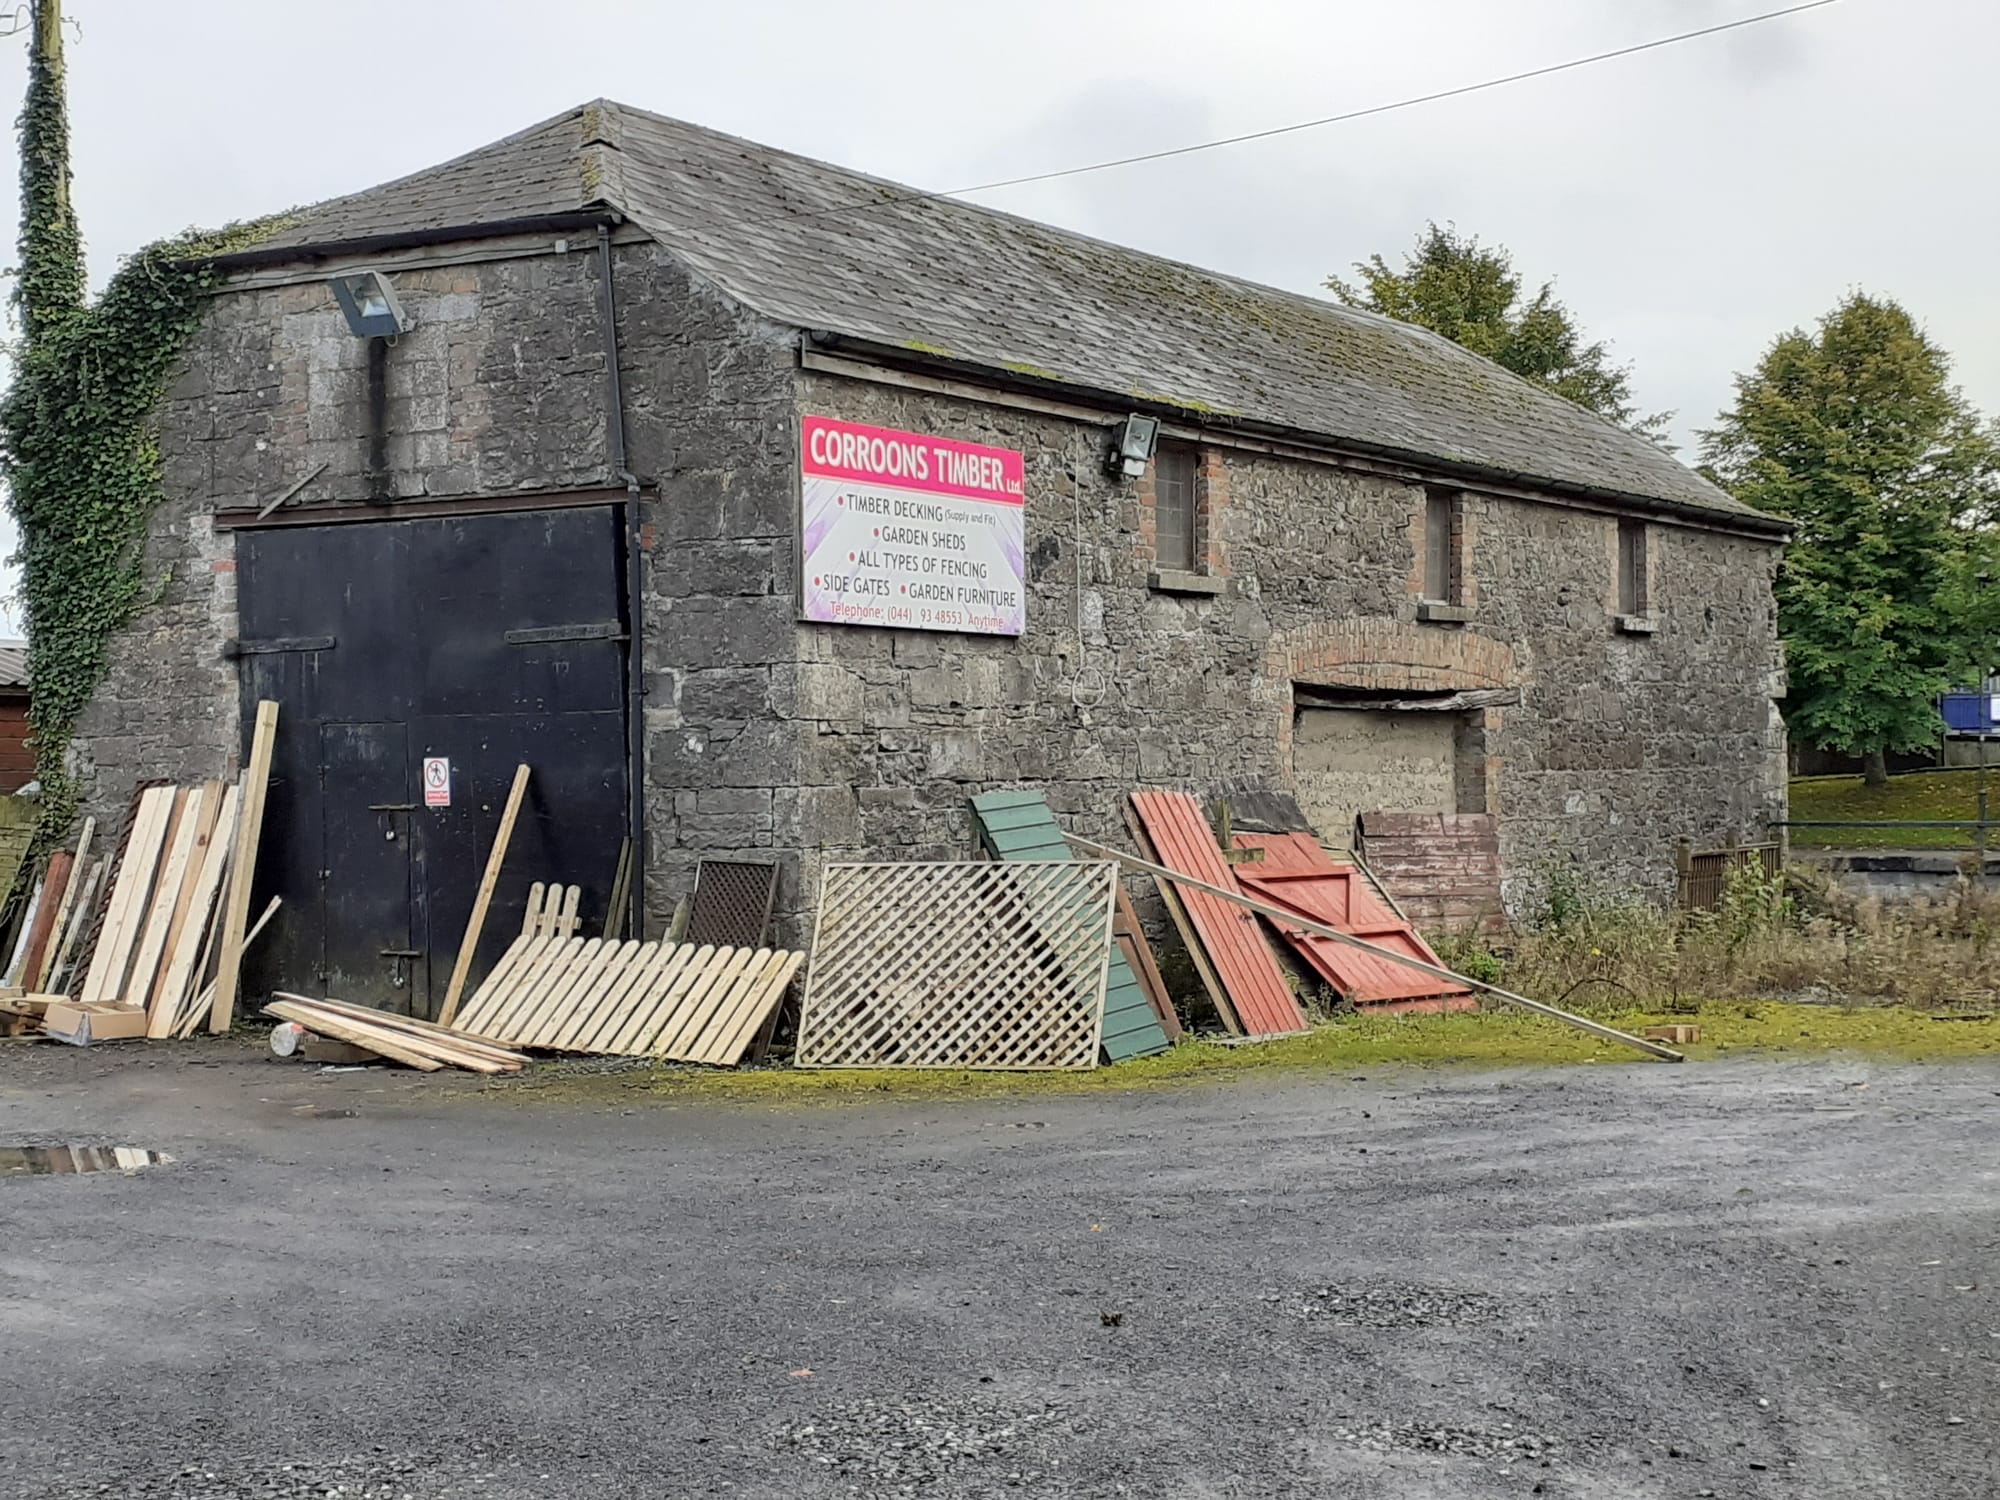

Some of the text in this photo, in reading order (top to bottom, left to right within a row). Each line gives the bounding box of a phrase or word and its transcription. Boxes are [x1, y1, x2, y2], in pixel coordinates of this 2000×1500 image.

[811, 428, 929, 481] CORROONS
[934, 448, 1005, 492] TIMBER
[847, 494, 891, 515] TIMBER
[895, 501, 943, 522] DECKING
[971, 513, 983, 524] and
[882, 526, 966, 551] GARDEN SHEDS
[858, 550, 987, 579] ALL TYPES OF FENCING
[824, 574, 890, 595] SIDE GATES
[909, 583, 1016, 607] GARDEN FURNITURE
[830, 601, 884, 619] Telephone:
[887, 606, 912, 623] (044)
[920, 608, 931, 622] 93
[968, 613, 1004, 629] Anytime
